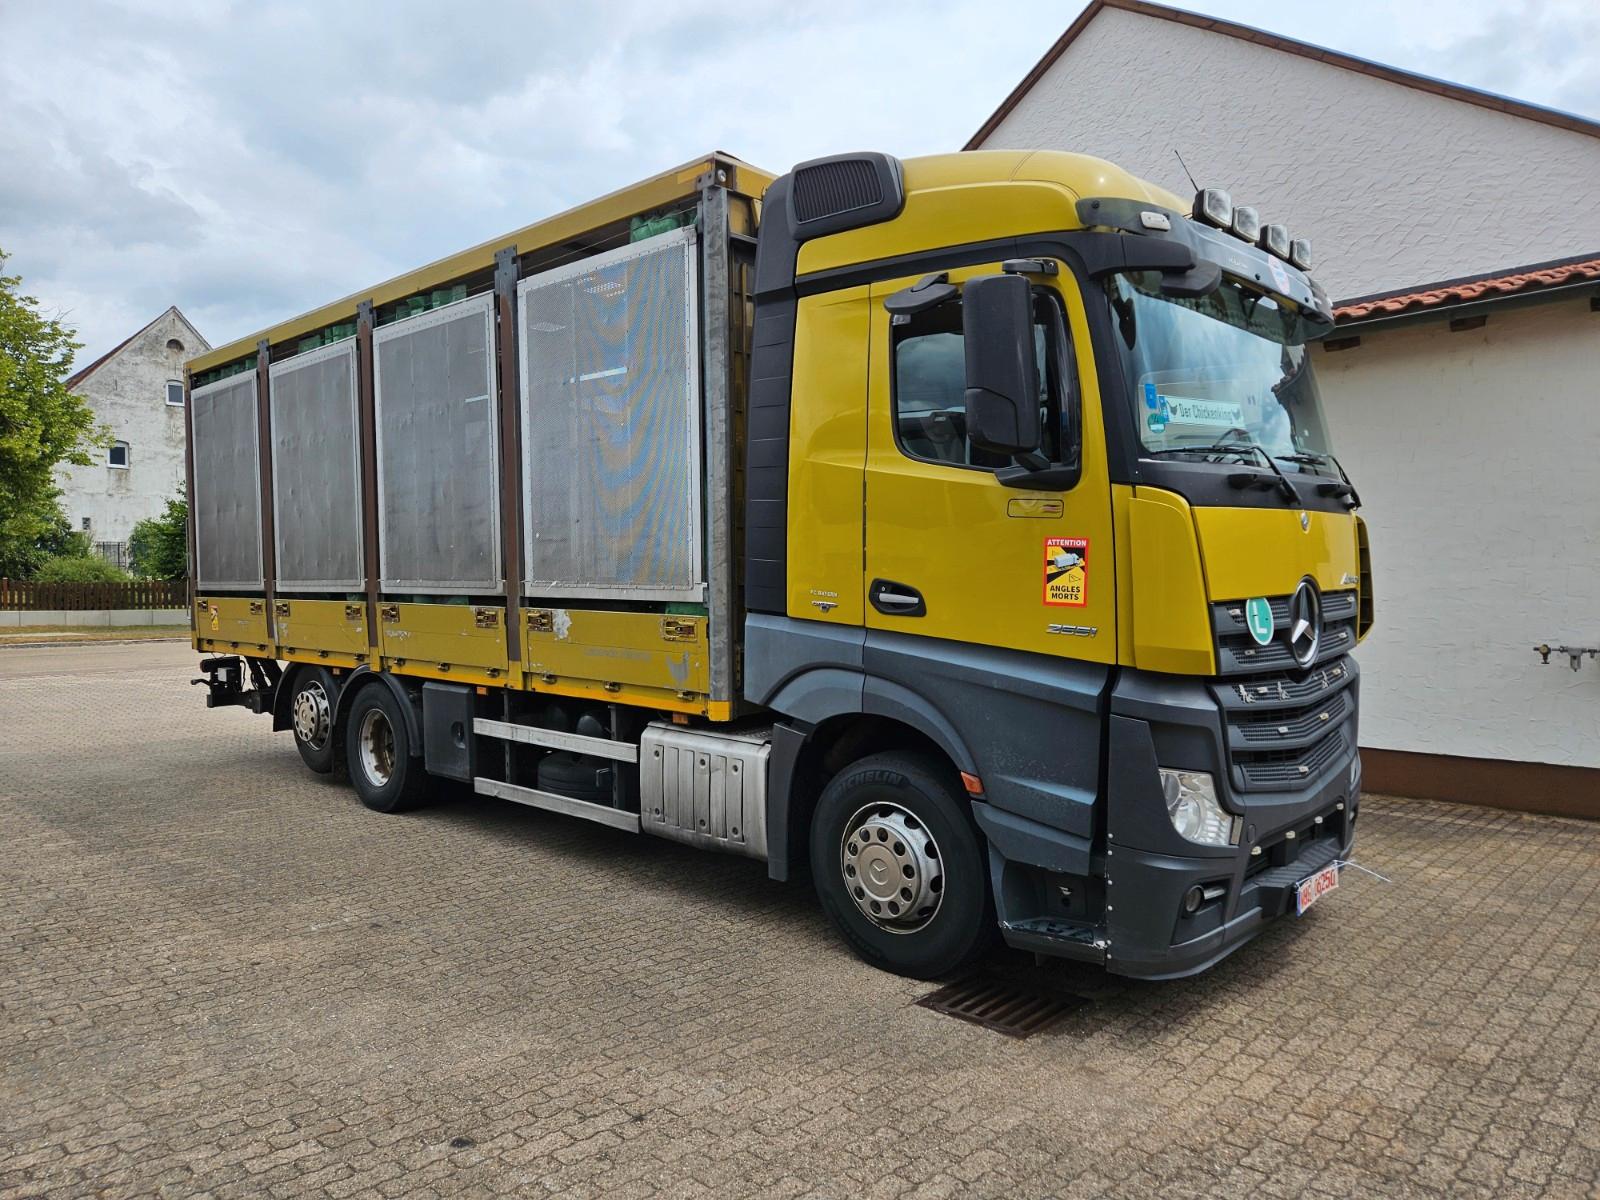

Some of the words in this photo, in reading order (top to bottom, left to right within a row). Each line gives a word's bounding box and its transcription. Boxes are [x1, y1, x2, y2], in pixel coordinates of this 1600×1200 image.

[1178, 403, 1191, 418] Der
[1047, 539, 1087, 547] ATTENTION
[1050, 585, 1081, 593] ANGLES
[1051, 593, 1080, 601] MORTS
[1252, 601, 1268, 634] L
